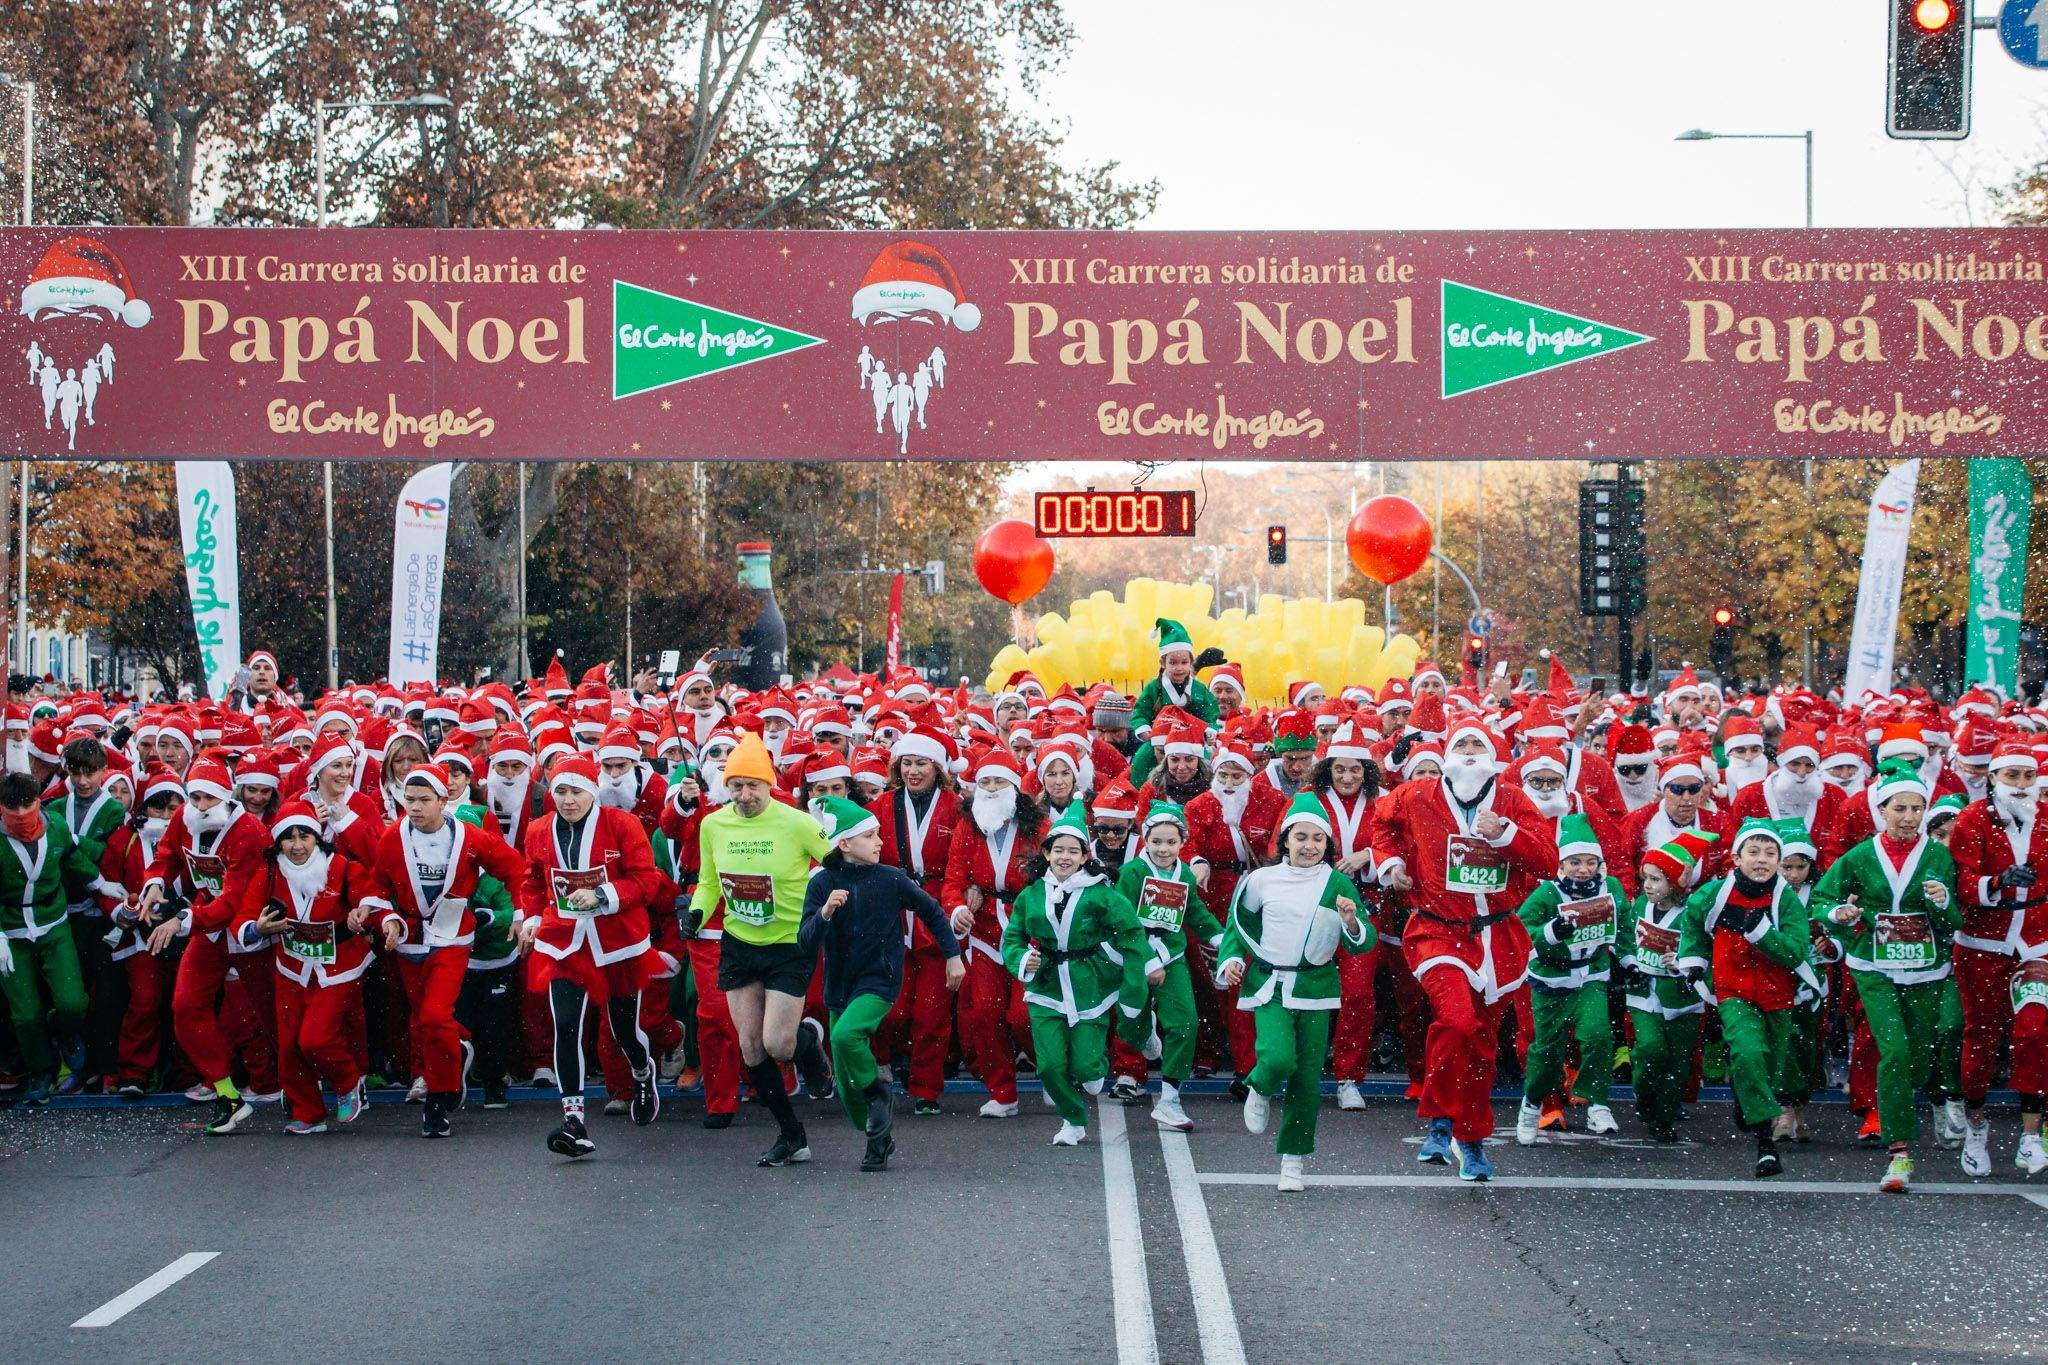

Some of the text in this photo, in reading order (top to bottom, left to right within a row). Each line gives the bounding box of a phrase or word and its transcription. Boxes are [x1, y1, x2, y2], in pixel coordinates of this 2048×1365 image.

[179, 254, 587, 285] XIII Carrera solidaria de
[1008, 255, 1415, 285] XIII Carrera solidaria de
[1684, 252, 2044, 284] XIII Carrera solidaria
[174, 295, 591, 383] Papá Noel
[619, 318, 774, 358] El Corte Inglés
[1004, 296, 1419, 386] Papá Noel
[1447, 317, 1603, 356] El Corte Inglés
[1680, 294, 2048, 383] Papá Noe
[267, 393, 495, 449] El Corte Inglés
[1097, 394, 1325, 450] El Corte Inglés
[1773, 391, 2006, 448] El Corte Inglés
[1459, 866, 1498, 884] 6424
[1147, 905, 1178, 924] 2890
[292, 940, 323, 956] 8211
[1886, 943, 1925, 960] 5303
[2020, 982, 2048, 998] 530
